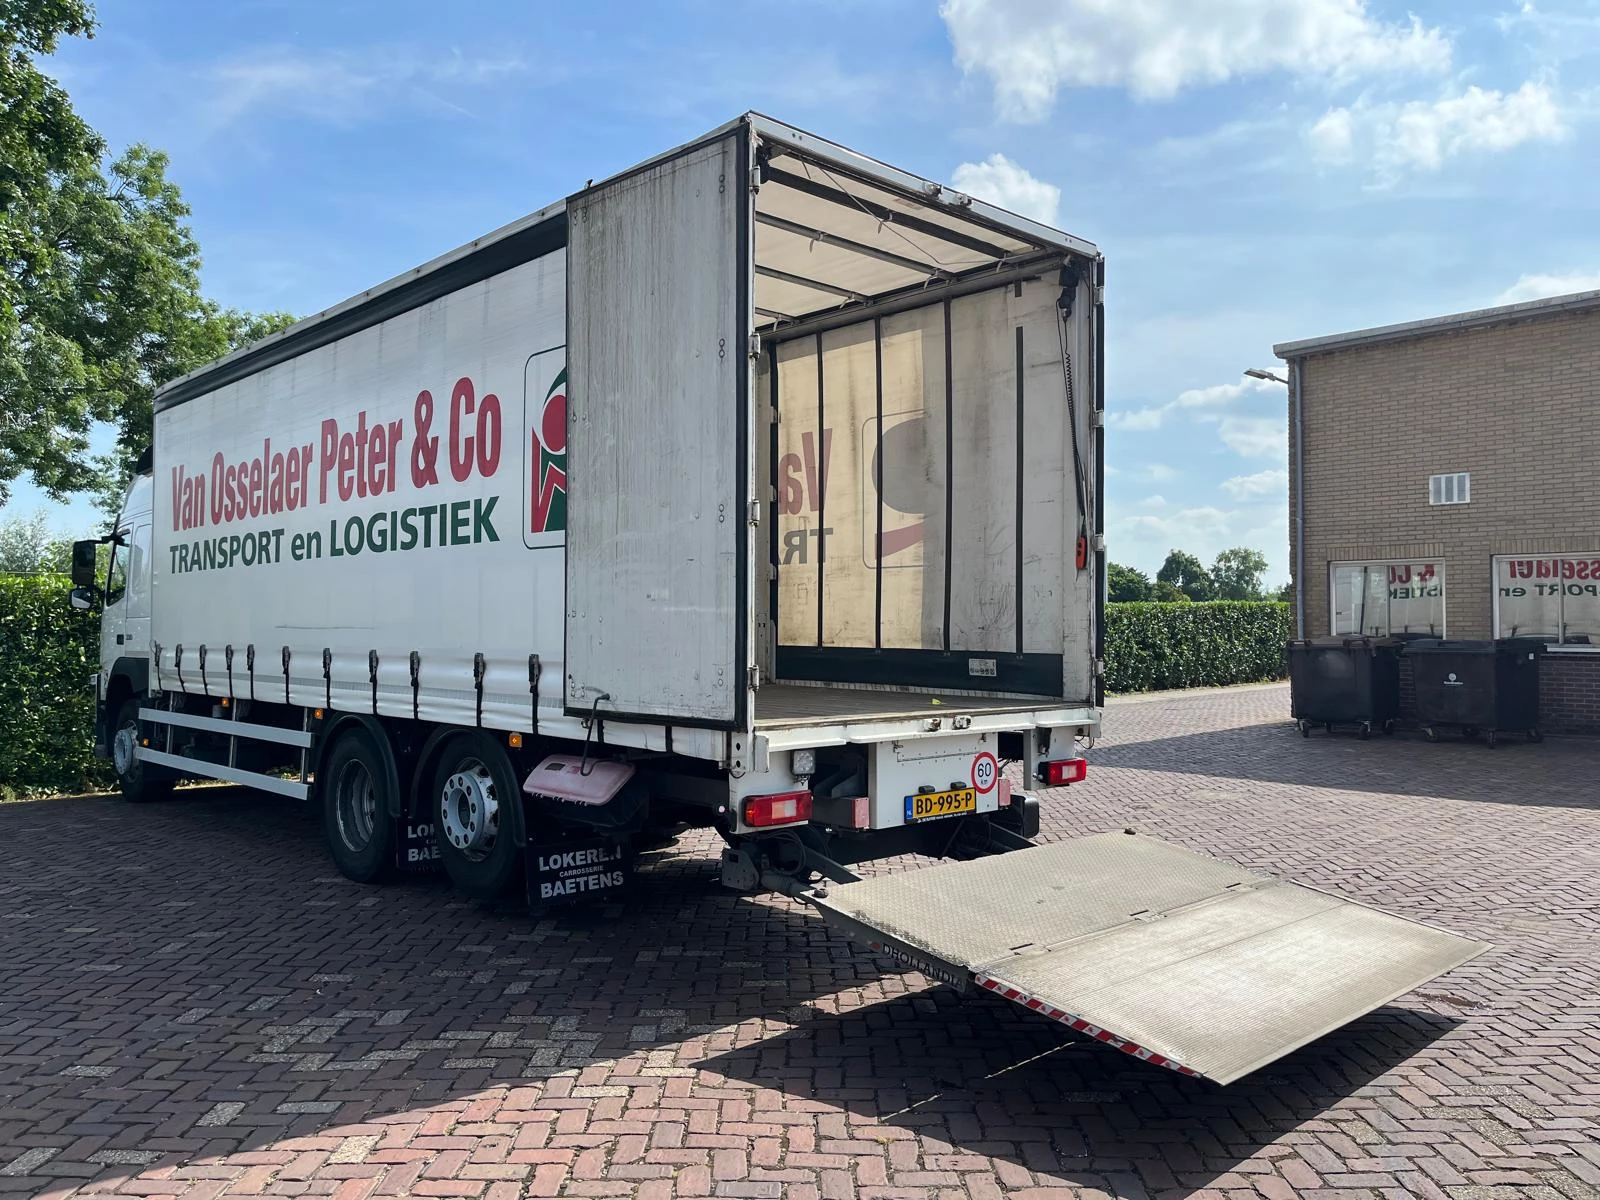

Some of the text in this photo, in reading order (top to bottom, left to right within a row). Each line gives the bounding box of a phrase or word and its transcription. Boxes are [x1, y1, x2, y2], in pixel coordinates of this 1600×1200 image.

[171, 376, 502, 531] Van Osselaer Peter & Co
[169, 495, 501, 574] TRANSPORT en LOGISTIEK
[977, 762, 992, 778] 60
[916, 792, 972, 815] BD-995-P
[540, 870, 624, 899] BAETENS
[559, 865, 604, 878] CARROSSERIE
